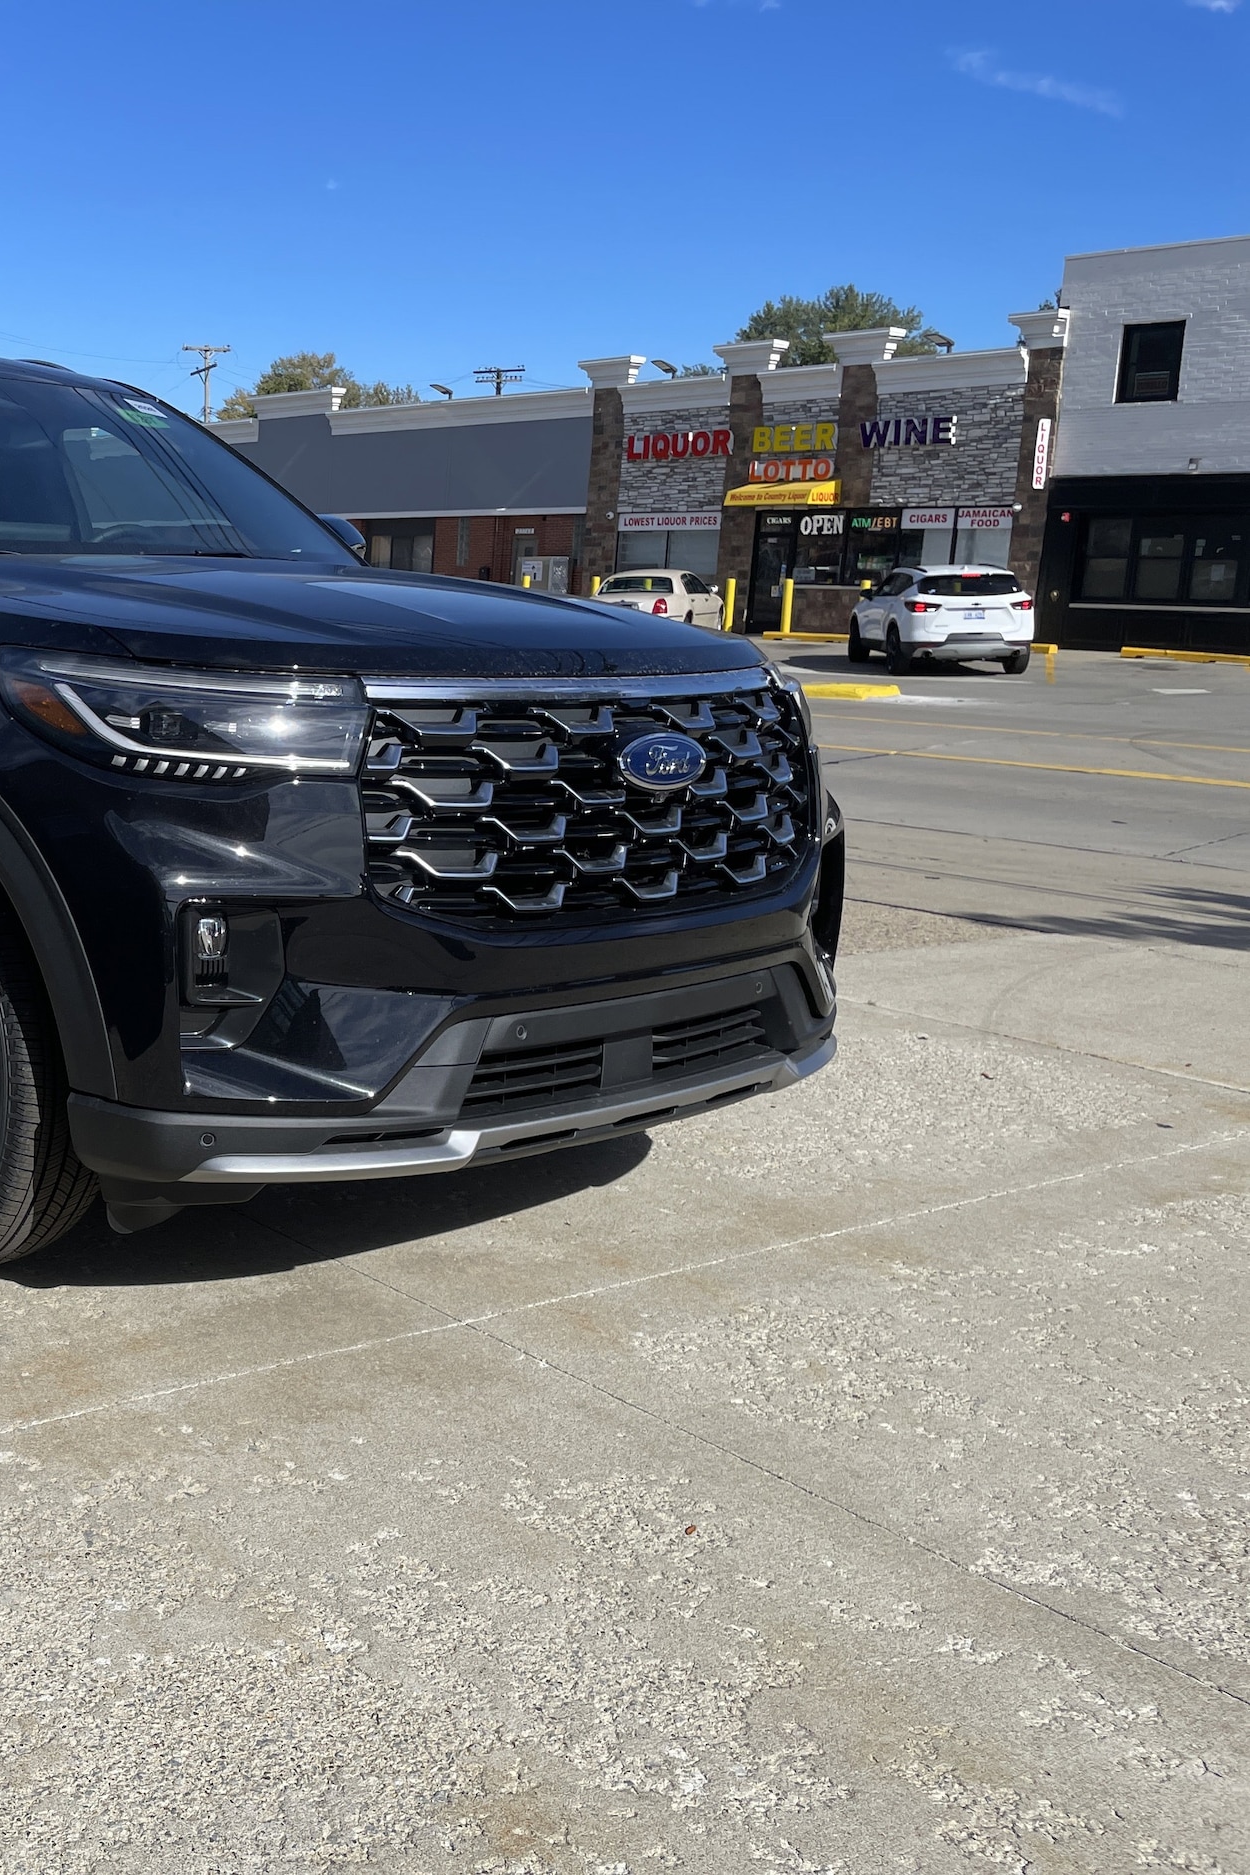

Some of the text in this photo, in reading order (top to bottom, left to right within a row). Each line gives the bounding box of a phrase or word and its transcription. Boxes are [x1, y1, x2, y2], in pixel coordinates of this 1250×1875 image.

[860, 415, 957, 448] WINE
[752, 422, 838, 453] BEER
[627, 429, 734, 461] LIQUOR
[1035, 422, 1047, 486] LIQUOR
[749, 458, 834, 483] LOTTO
[730, 492, 808, 502] Welcome to Country Liquor
[811, 492, 840, 503] LIQUOR
[909, 513, 948, 524] CIGARS
[958, 509, 1014, 518] JAMAICAN
[624, 516, 718, 527] LOWEST LIQUOR PRICES
[766, 516, 792, 525] CIGARS
[800, 514, 845, 536] OPEN
[851, 517, 898, 528] ATM/EBT
[970, 519, 1001, 528] FOOD
[646, 745, 690, 776] Ford
